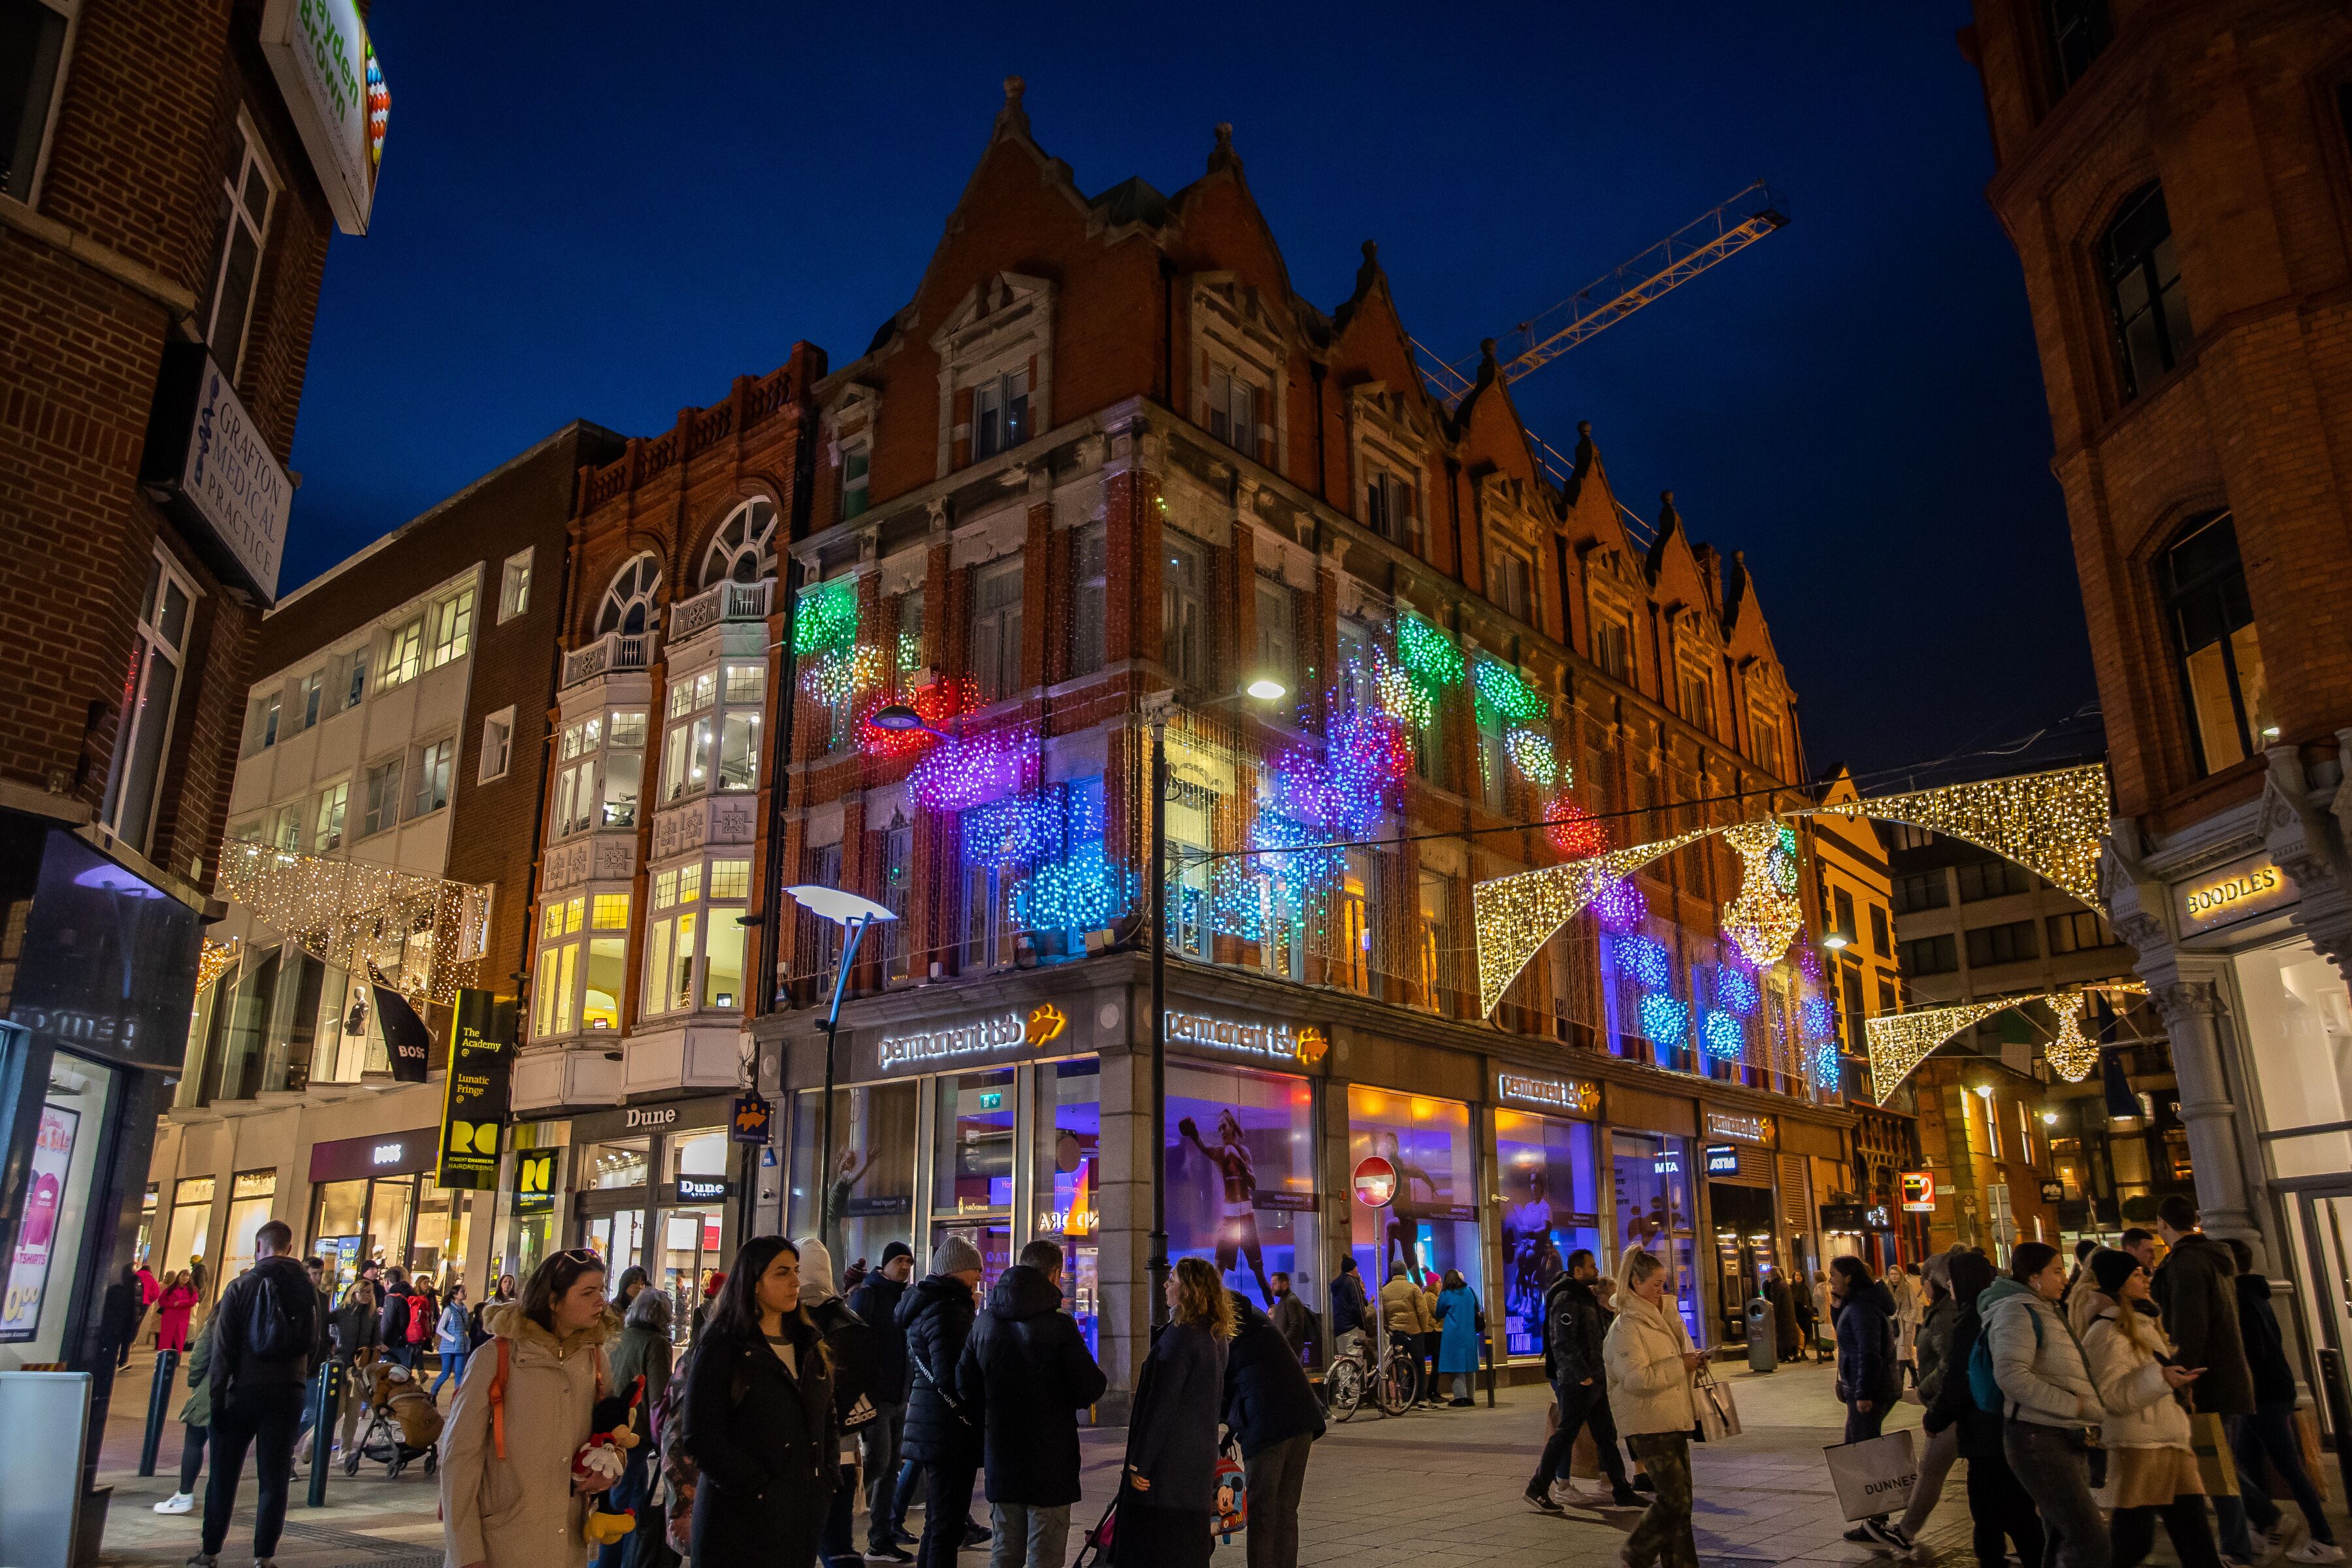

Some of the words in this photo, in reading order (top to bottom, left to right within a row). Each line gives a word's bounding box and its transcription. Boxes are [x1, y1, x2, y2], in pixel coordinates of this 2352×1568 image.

[300, 0, 346, 125] Brown
[220, 402, 282, 508] GRAFTON
[213, 433, 276, 544] MEDICAL
[207, 472, 272, 576] PRACTICE
[2186, 869, 2276, 914] BOODLES
[463, 1027, 480, 1037] The
[877, 1022, 986, 1066] permanent
[987, 1013, 1022, 1047] tsb
[1165, 1012, 1269, 1051] permanent
[1269, 1026, 1299, 1056] tsb
[461, 1049, 470, 1057] @
[462, 1038, 502, 1053] Academy
[458, 1073, 490, 1085] Lunatic
[456, 1095, 465, 1103] @
[457, 1085, 484, 1097] Fringe
[626, 1109, 676, 1128] Dune
[1710, 1157, 1735, 1170] ATM
[680, 1181, 725, 1194] Dune
[342, 1248, 356, 1258] SALE
[1506, 1316, 1524, 1334] RAISING
[1511, 1334, 1515, 1352] A
[1515, 1333, 1531, 1351] NATION
[845, 1409, 877, 1426] adidas
[1865, 1473, 1918, 1495] DUNNES
